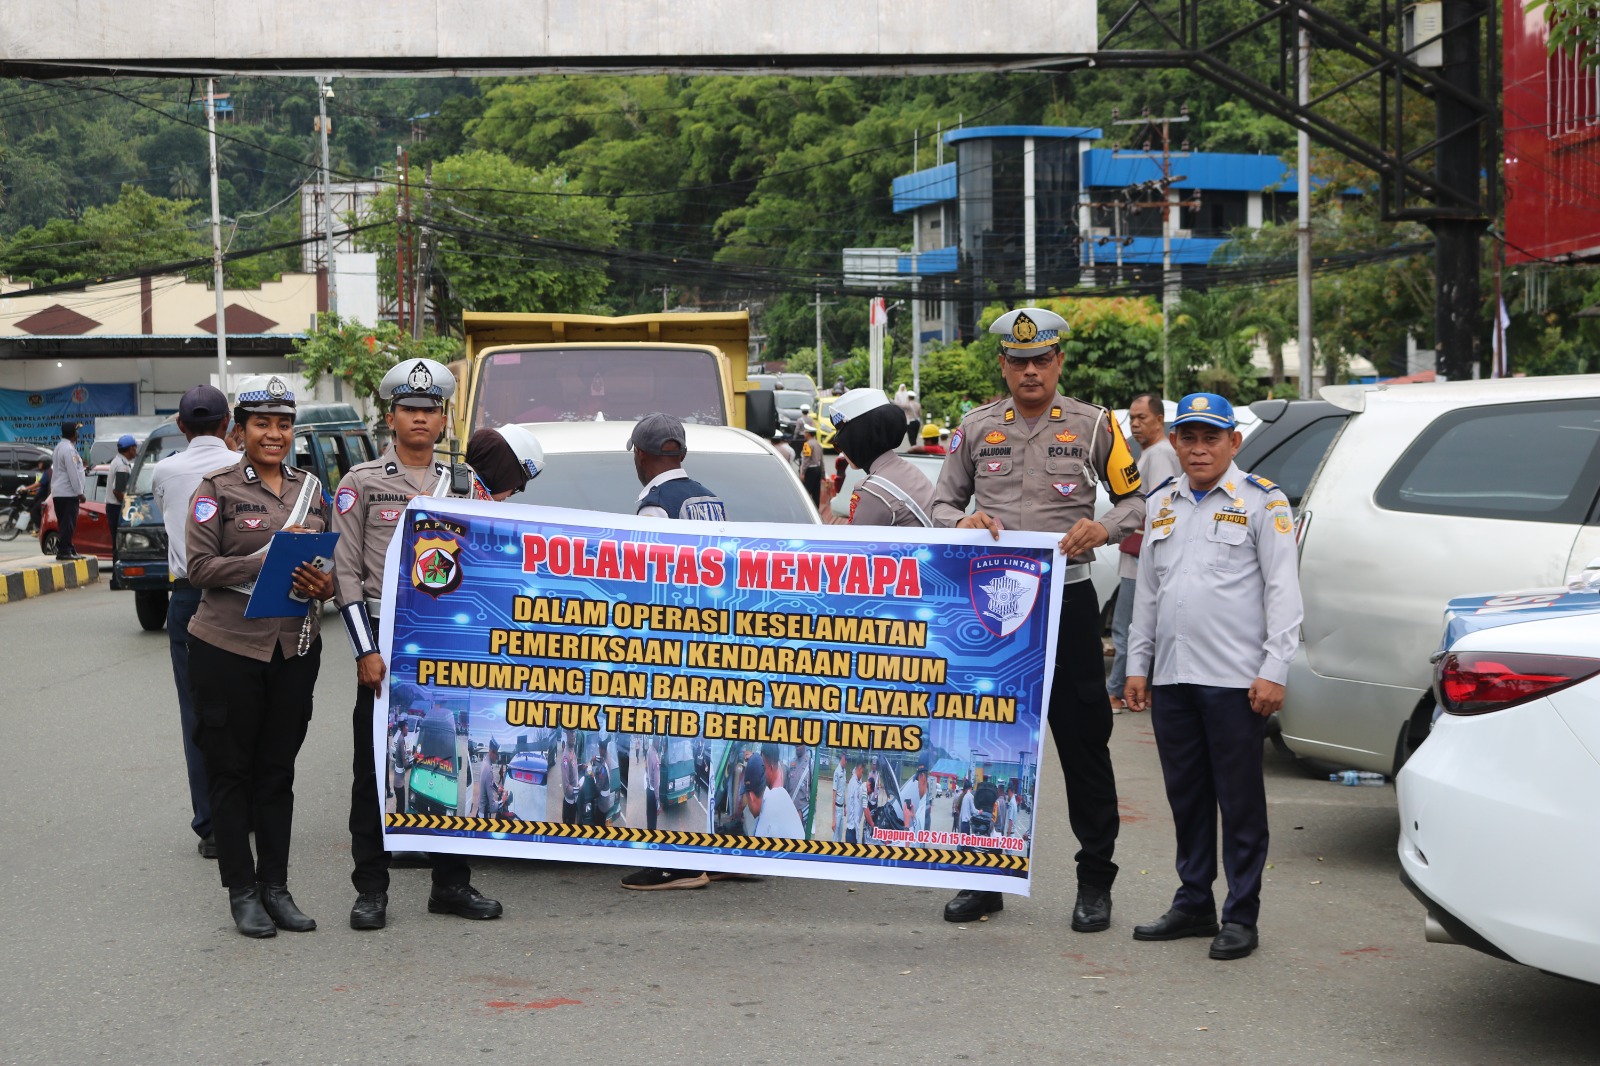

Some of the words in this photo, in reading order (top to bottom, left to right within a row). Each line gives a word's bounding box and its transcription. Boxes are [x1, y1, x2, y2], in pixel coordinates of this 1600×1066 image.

[979, 446, 1012, 457] JALUDDIN
[1047, 446, 1083, 457] POLRI
[235, 503, 267, 513] MELISA
[1215, 513, 1246, 524] DISHUB
[415, 522, 461, 534] PAPUA
[521, 533, 727, 588] POLANTAS
[736, 548, 923, 598] MENYAPA
[976, 559, 1000, 569] LALU
[1003, 559, 1036, 571] LINTAS
[514, 596, 608, 627] DALAM
[612, 601, 729, 635] OPERASI
[735, 610, 927, 648] KESELAMATAN
[490, 628, 682, 667] PEMERIKSAAN
[687, 640, 851, 678] KENDARAAN
[857, 652, 947, 685] UMUM
[417, 659, 585, 695] PENUMPANG
[590, 669, 648, 699] DAN
[652, 672, 765, 707] BARANG
[769, 681, 842, 713] YANG
[846, 686, 931, 718] LAYAK
[932, 692, 1017, 724] JALAN
[506, 698, 601, 731] UNTUK
[604, 704, 700, 738] TERTIB
[703, 711, 823, 746] BERLALU
[826, 719, 922, 752] LINTAS
[873, 827, 916, 843] Jayapura,
[917, 831, 930, 843] 02
[931, 831, 947, 845] S/d
[949, 833, 960, 845] 15
[961, 833, 999, 848] Februari
[1000, 837, 1024, 851] 2026
